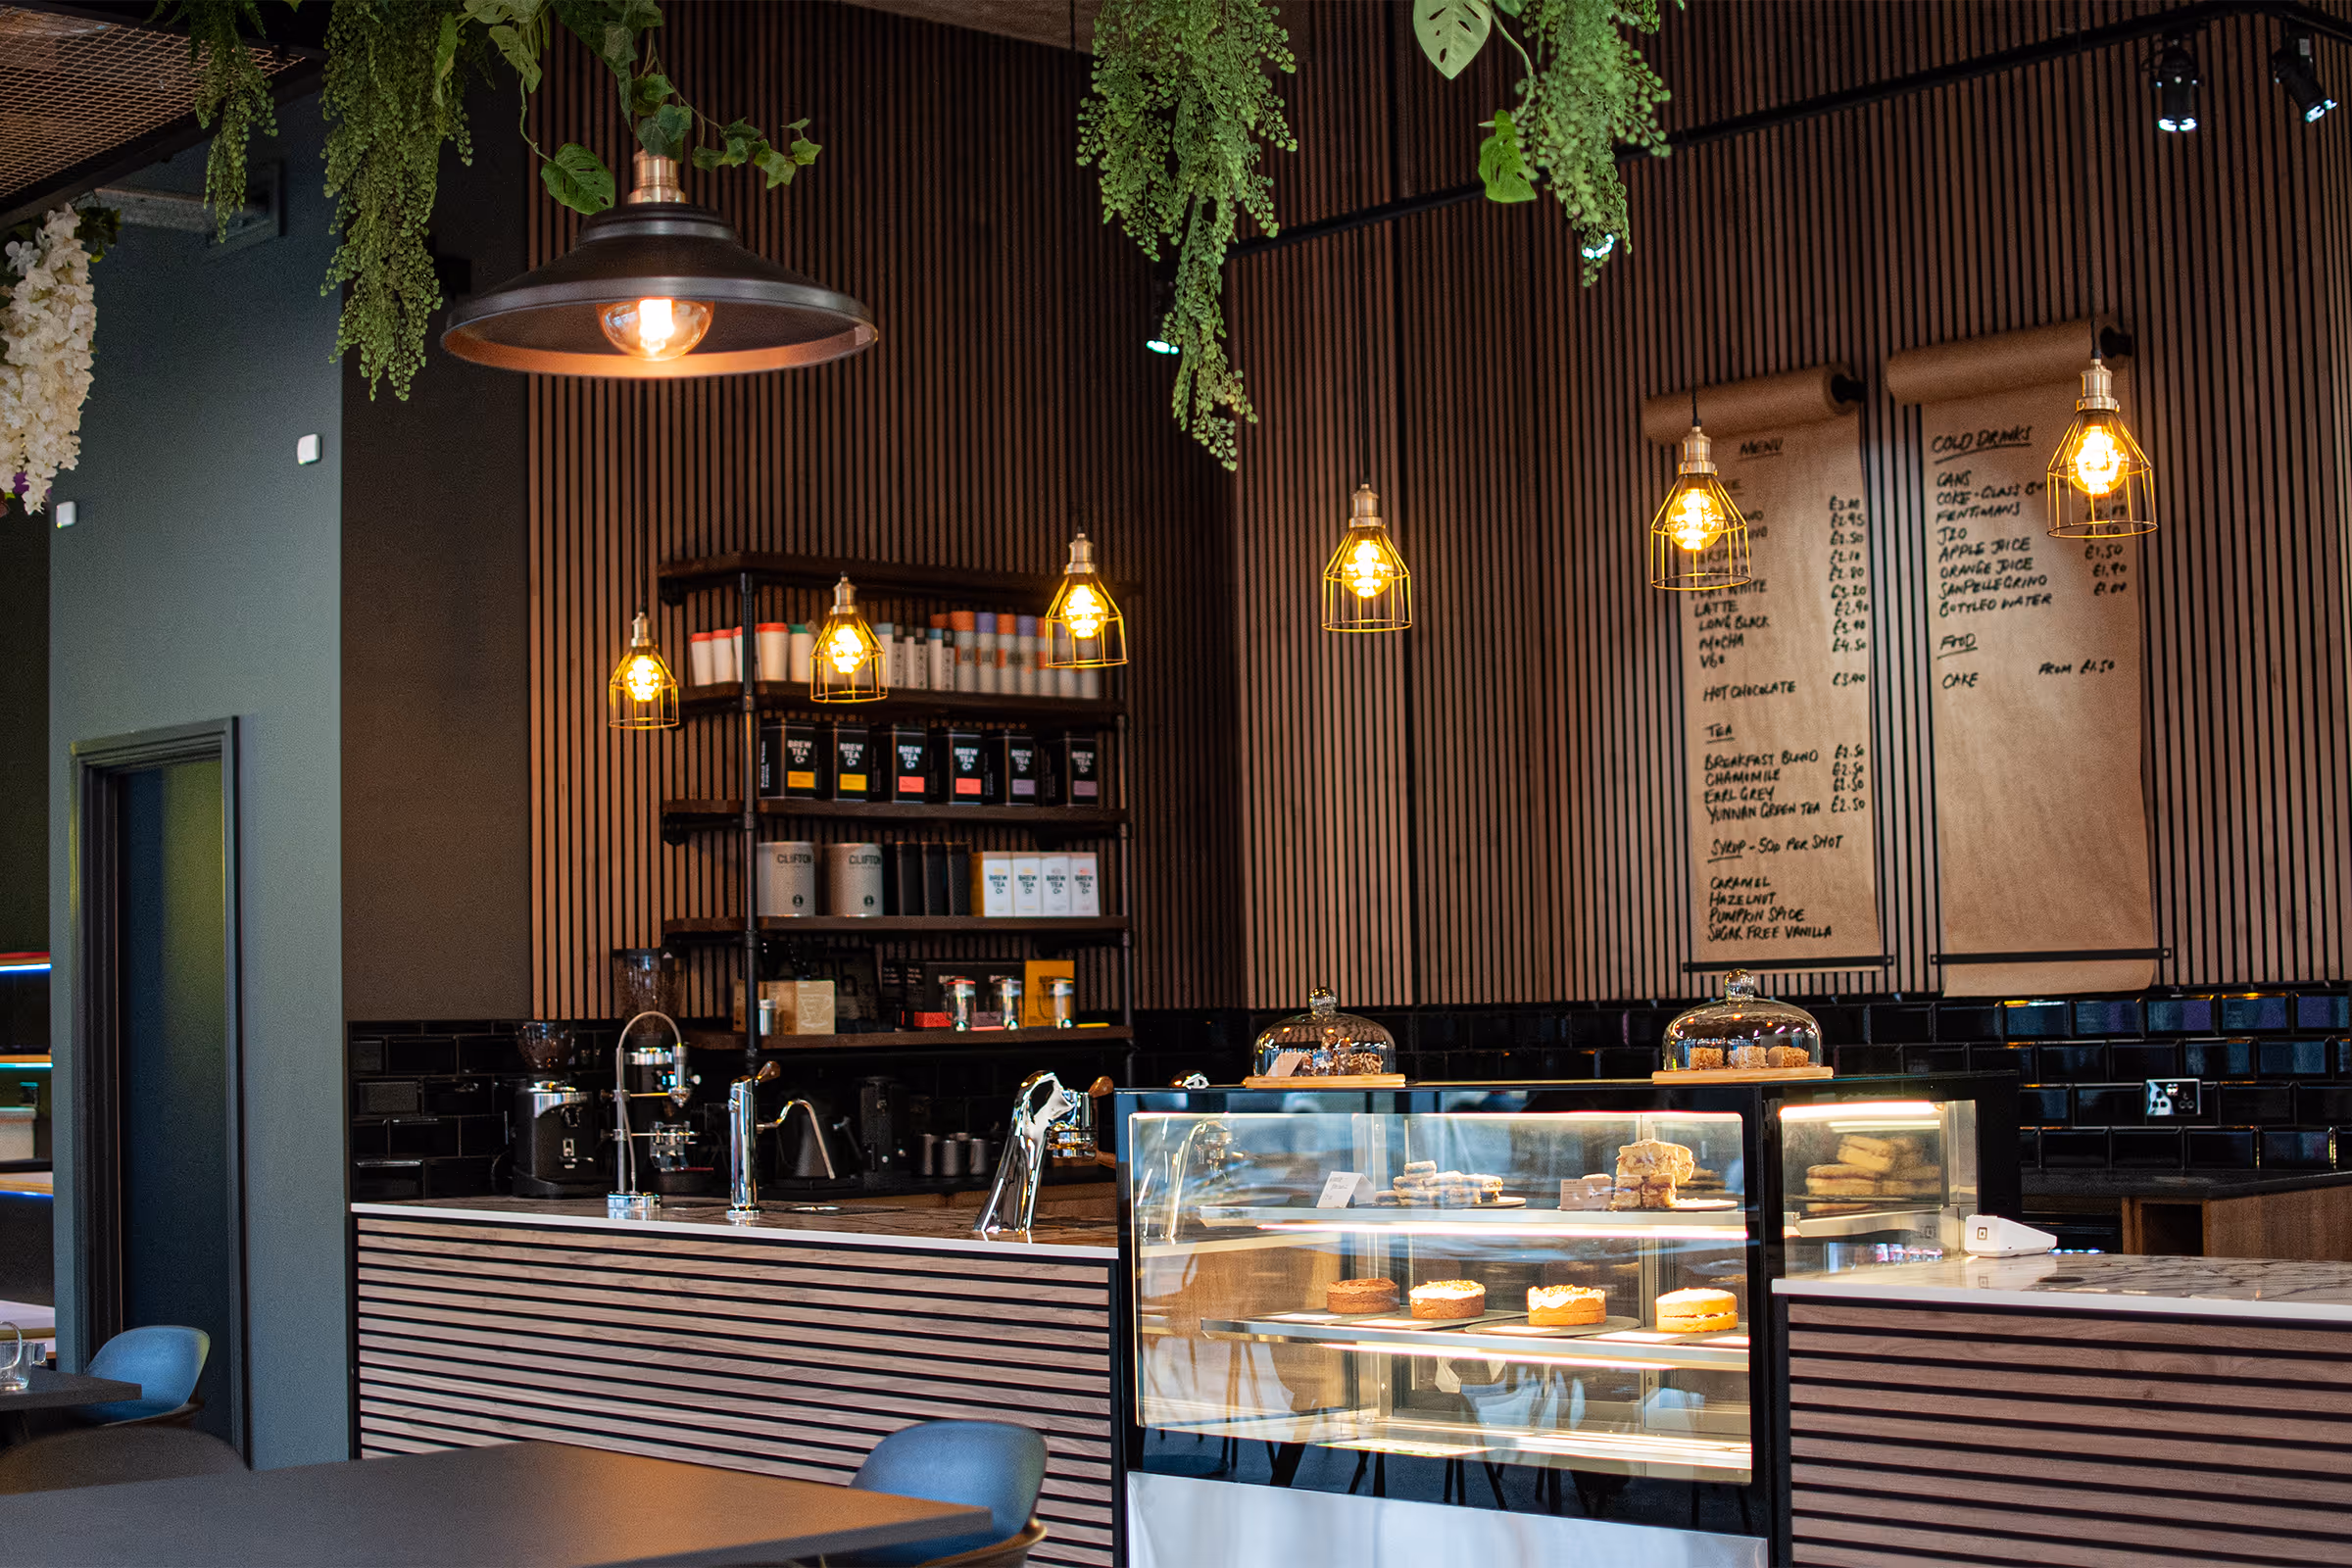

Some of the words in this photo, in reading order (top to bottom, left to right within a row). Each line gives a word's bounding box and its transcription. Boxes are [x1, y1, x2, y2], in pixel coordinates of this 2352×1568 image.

[1740, 438, 1784, 455] MENU
[1932, 432, 1973, 453] COLD
[1936, 470, 1972, 487] CANS
[1936, 491, 1972, 506] COKE
[1936, 502, 2021, 523] FENTIMANS
[1938, 542, 1984, 564] APPLE
[1990, 537, 2032, 555] JUICE
[2084, 544, 2124, 560] £1.50
[1940, 560, 1991, 578] ORANGE
[1996, 557, 2034, 574] JUICE
[1694, 600, 1739, 617] LATTE
[1939, 598, 1997, 618] BOTTLED
[2001, 593, 2052, 610] WATER
[1699, 614, 1732, 632] LONG
[1735, 615, 1771, 629] BLACK
[1698, 633, 1743, 651] MOCHA
[1832, 638, 1867, 653] £4.50
[1939, 633, 1976, 650] FOOD
[1942, 672, 1979, 689] CAKE
[2038, 662, 2072, 675] FROM
[1703, 684, 1729, 702] HOT
[1731, 680, 1795, 699] CHOCOLATE
[1704, 723, 1733, 737] TEA
[787, 739, 812, 749] BREW
[839, 742, 864, 752] BREW
[899, 745, 922, 755] BREW
[955, 747, 979, 757] BREW
[1010, 749, 1033, 758] BREW
[1071, 751, 1095, 760] BREW
[1704, 753, 1775, 771] BREAKFAST
[1782, 749, 1819, 765] BLEND
[1705, 768, 1781, 787] CHAMOMILE
[1704, 788, 1737, 805] EARL
[1740, 785, 1775, 802] GREY
[1705, 804, 1757, 825] YUNNAN
[1760, 801, 1796, 818] GREEN
[1800, 802, 1821, 815] TEA
[1831, 795, 1865, 813] £2.50
[1710, 838, 1746, 857] SYRUP
[1786, 837, 1809, 851] PER
[1811, 834, 1844, 850] SHOT
[1710, 876, 1771, 890] CARAMEL
[1709, 891, 1777, 907] HAZELNUT
[1709, 906, 1764, 923] PUMPKIN
[1768, 906, 1804, 922] SPICE
[1708, 923, 1743, 942] SUGAR
[1746, 925, 1780, 940] FREE
[1785, 925, 1832, 939] VANILLA
